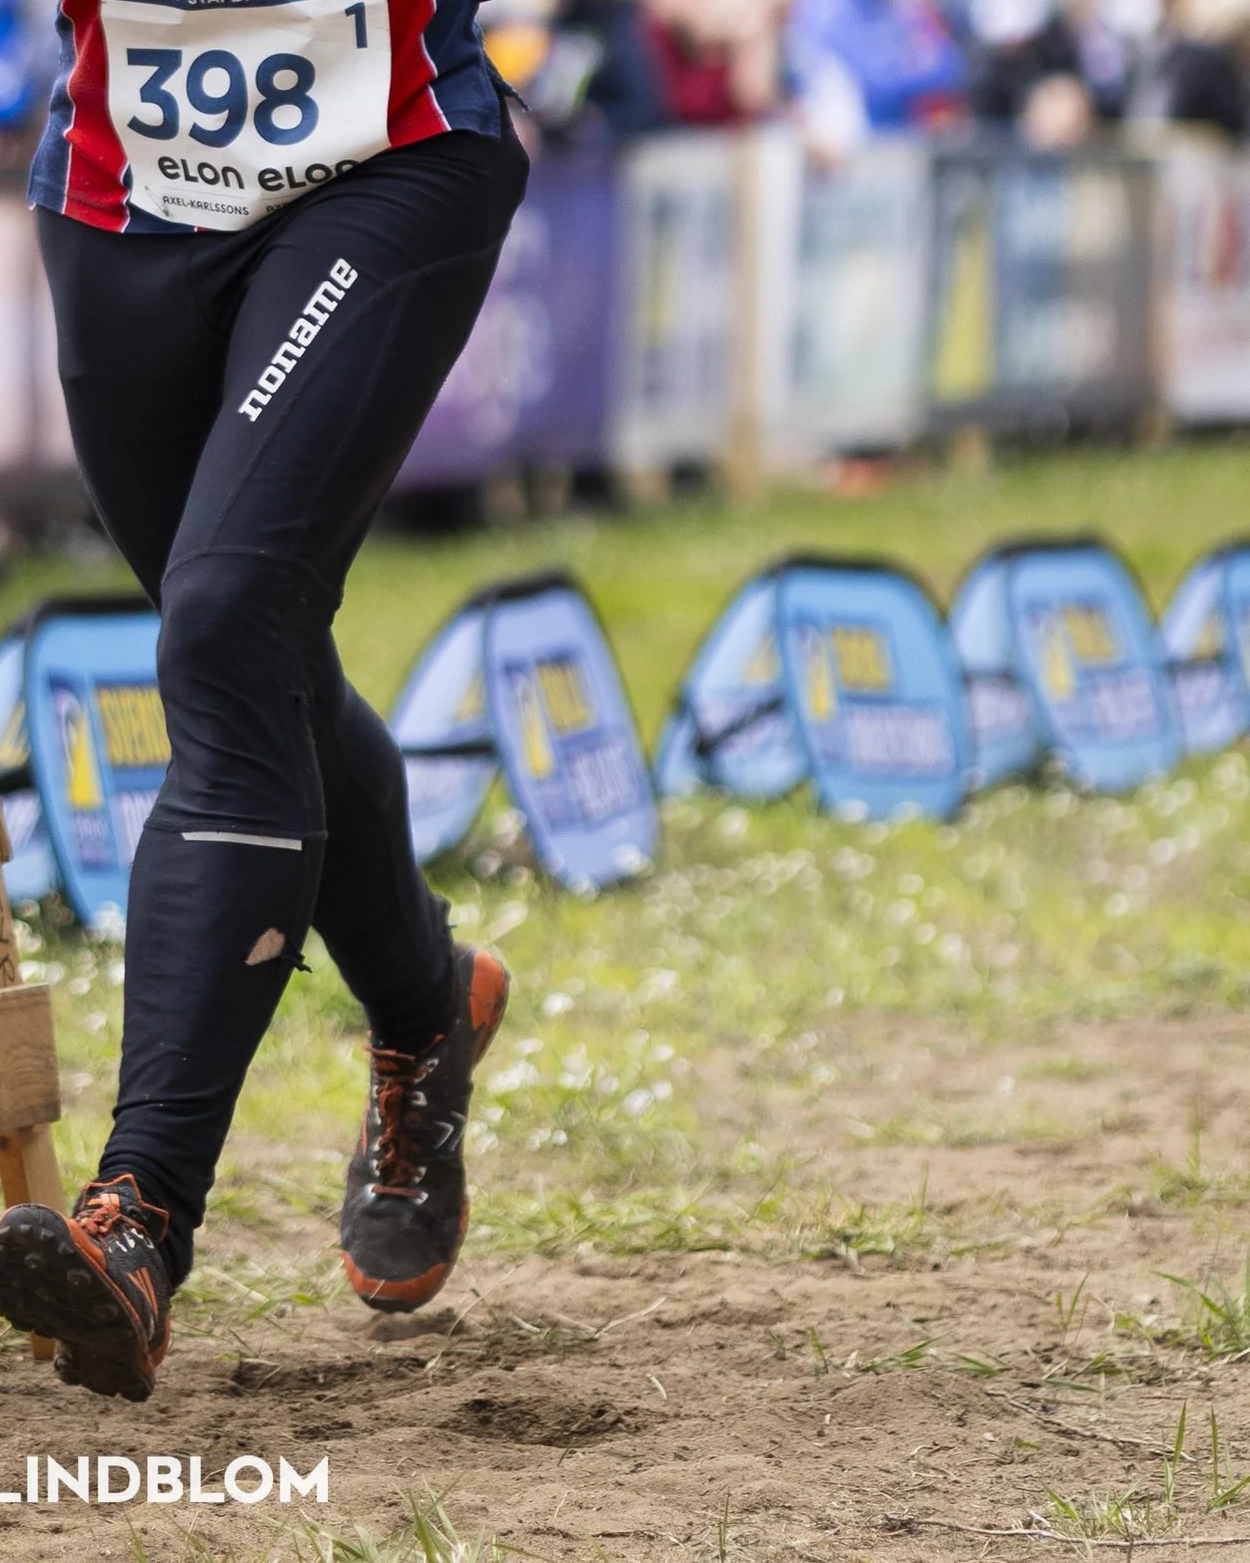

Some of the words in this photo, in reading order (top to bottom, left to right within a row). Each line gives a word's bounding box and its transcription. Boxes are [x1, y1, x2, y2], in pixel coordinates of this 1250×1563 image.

[345, 2, 368, 49] 1
[126, 47, 320, 149] 398
[162, 195, 250, 216] AXEL-KARLSSONS
[238, 257, 359, 423] noname
